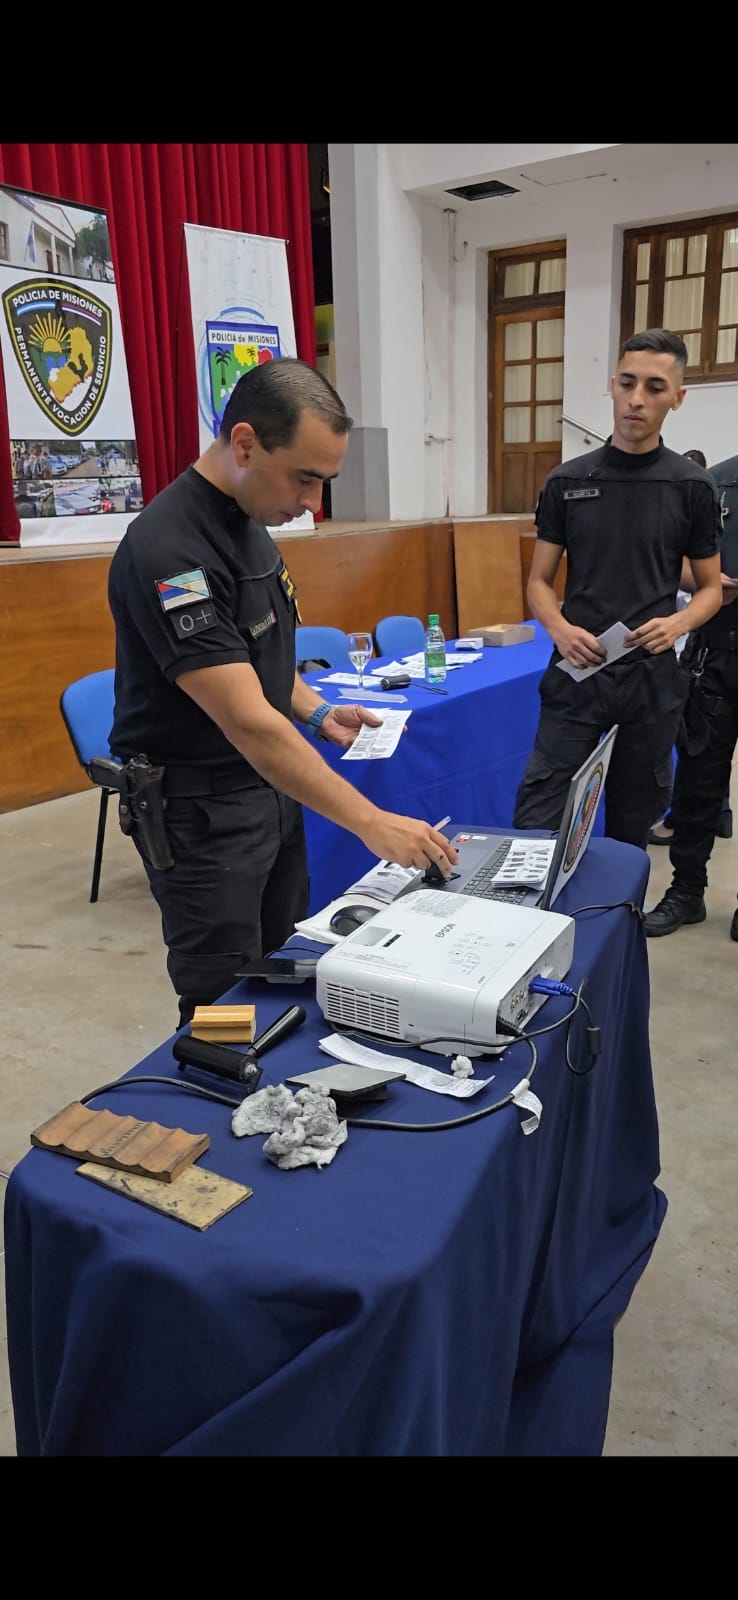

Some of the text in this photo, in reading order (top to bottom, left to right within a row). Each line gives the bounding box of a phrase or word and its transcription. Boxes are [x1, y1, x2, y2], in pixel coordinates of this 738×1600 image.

[12, 290, 103, 318] POLICIA DE MISIONES
[211, 332, 276, 345] POLICIA de MISIONES
[15, 327, 107, 426] PERMANENTE VOCACION DE SERVICIO
[434, 922, 457, 938] EPSON
